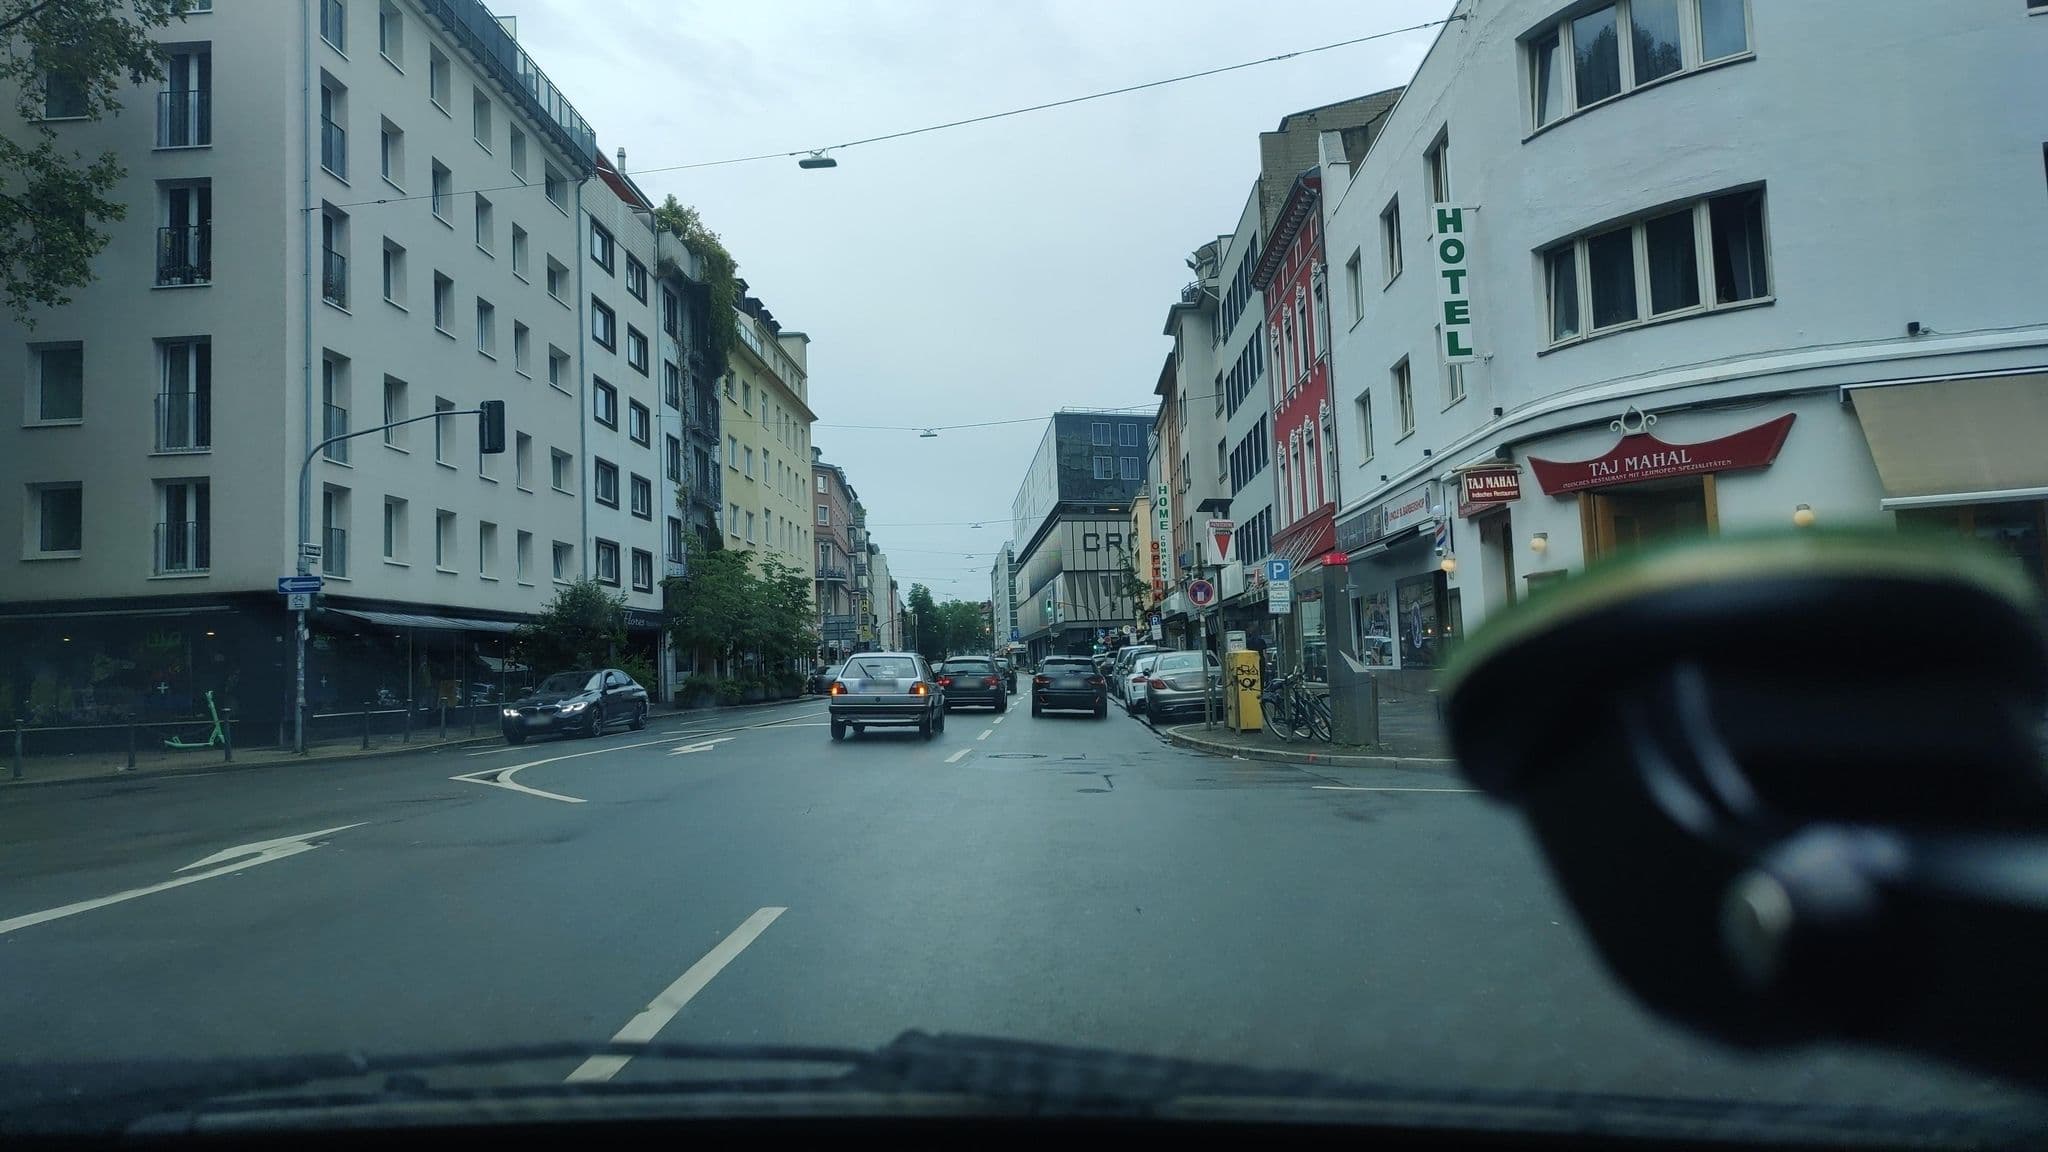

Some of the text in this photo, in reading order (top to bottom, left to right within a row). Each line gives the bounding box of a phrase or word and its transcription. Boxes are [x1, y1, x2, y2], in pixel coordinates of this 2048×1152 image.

[1437, 208, 1473, 357] HOTEL
[1589, 449, 1692, 477] TAJ MAHAL
[1628, 471, 1640, 479] MIT
[1467, 475, 1518, 489] TAJ MAHAL
[1158, 485, 1169, 578] HOME COMPANY
[1152, 542, 1161, 600] OPTIK
[1273, 562, 1285, 579] P
